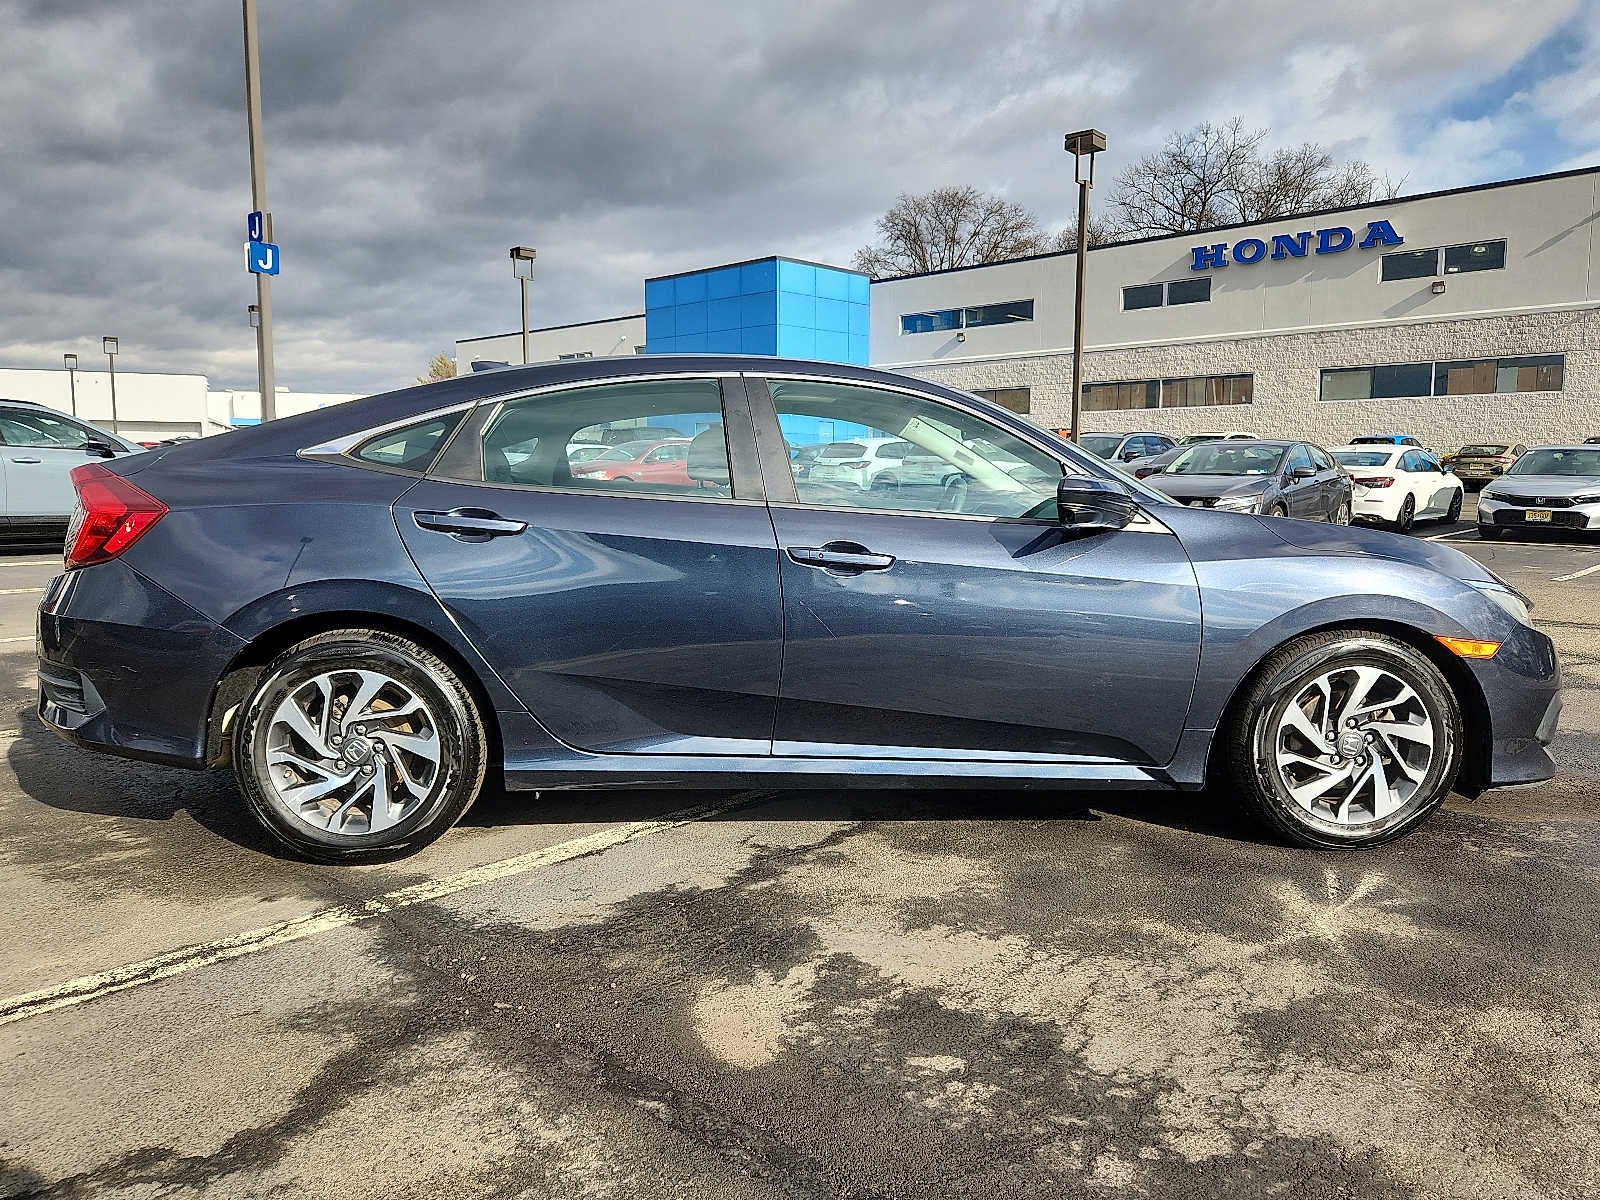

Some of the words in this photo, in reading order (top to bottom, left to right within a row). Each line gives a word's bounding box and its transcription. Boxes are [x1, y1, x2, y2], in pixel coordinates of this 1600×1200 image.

[252, 216, 260, 238] J
[1190, 219, 1404, 270] HONDA
[258, 248, 273, 270] J
